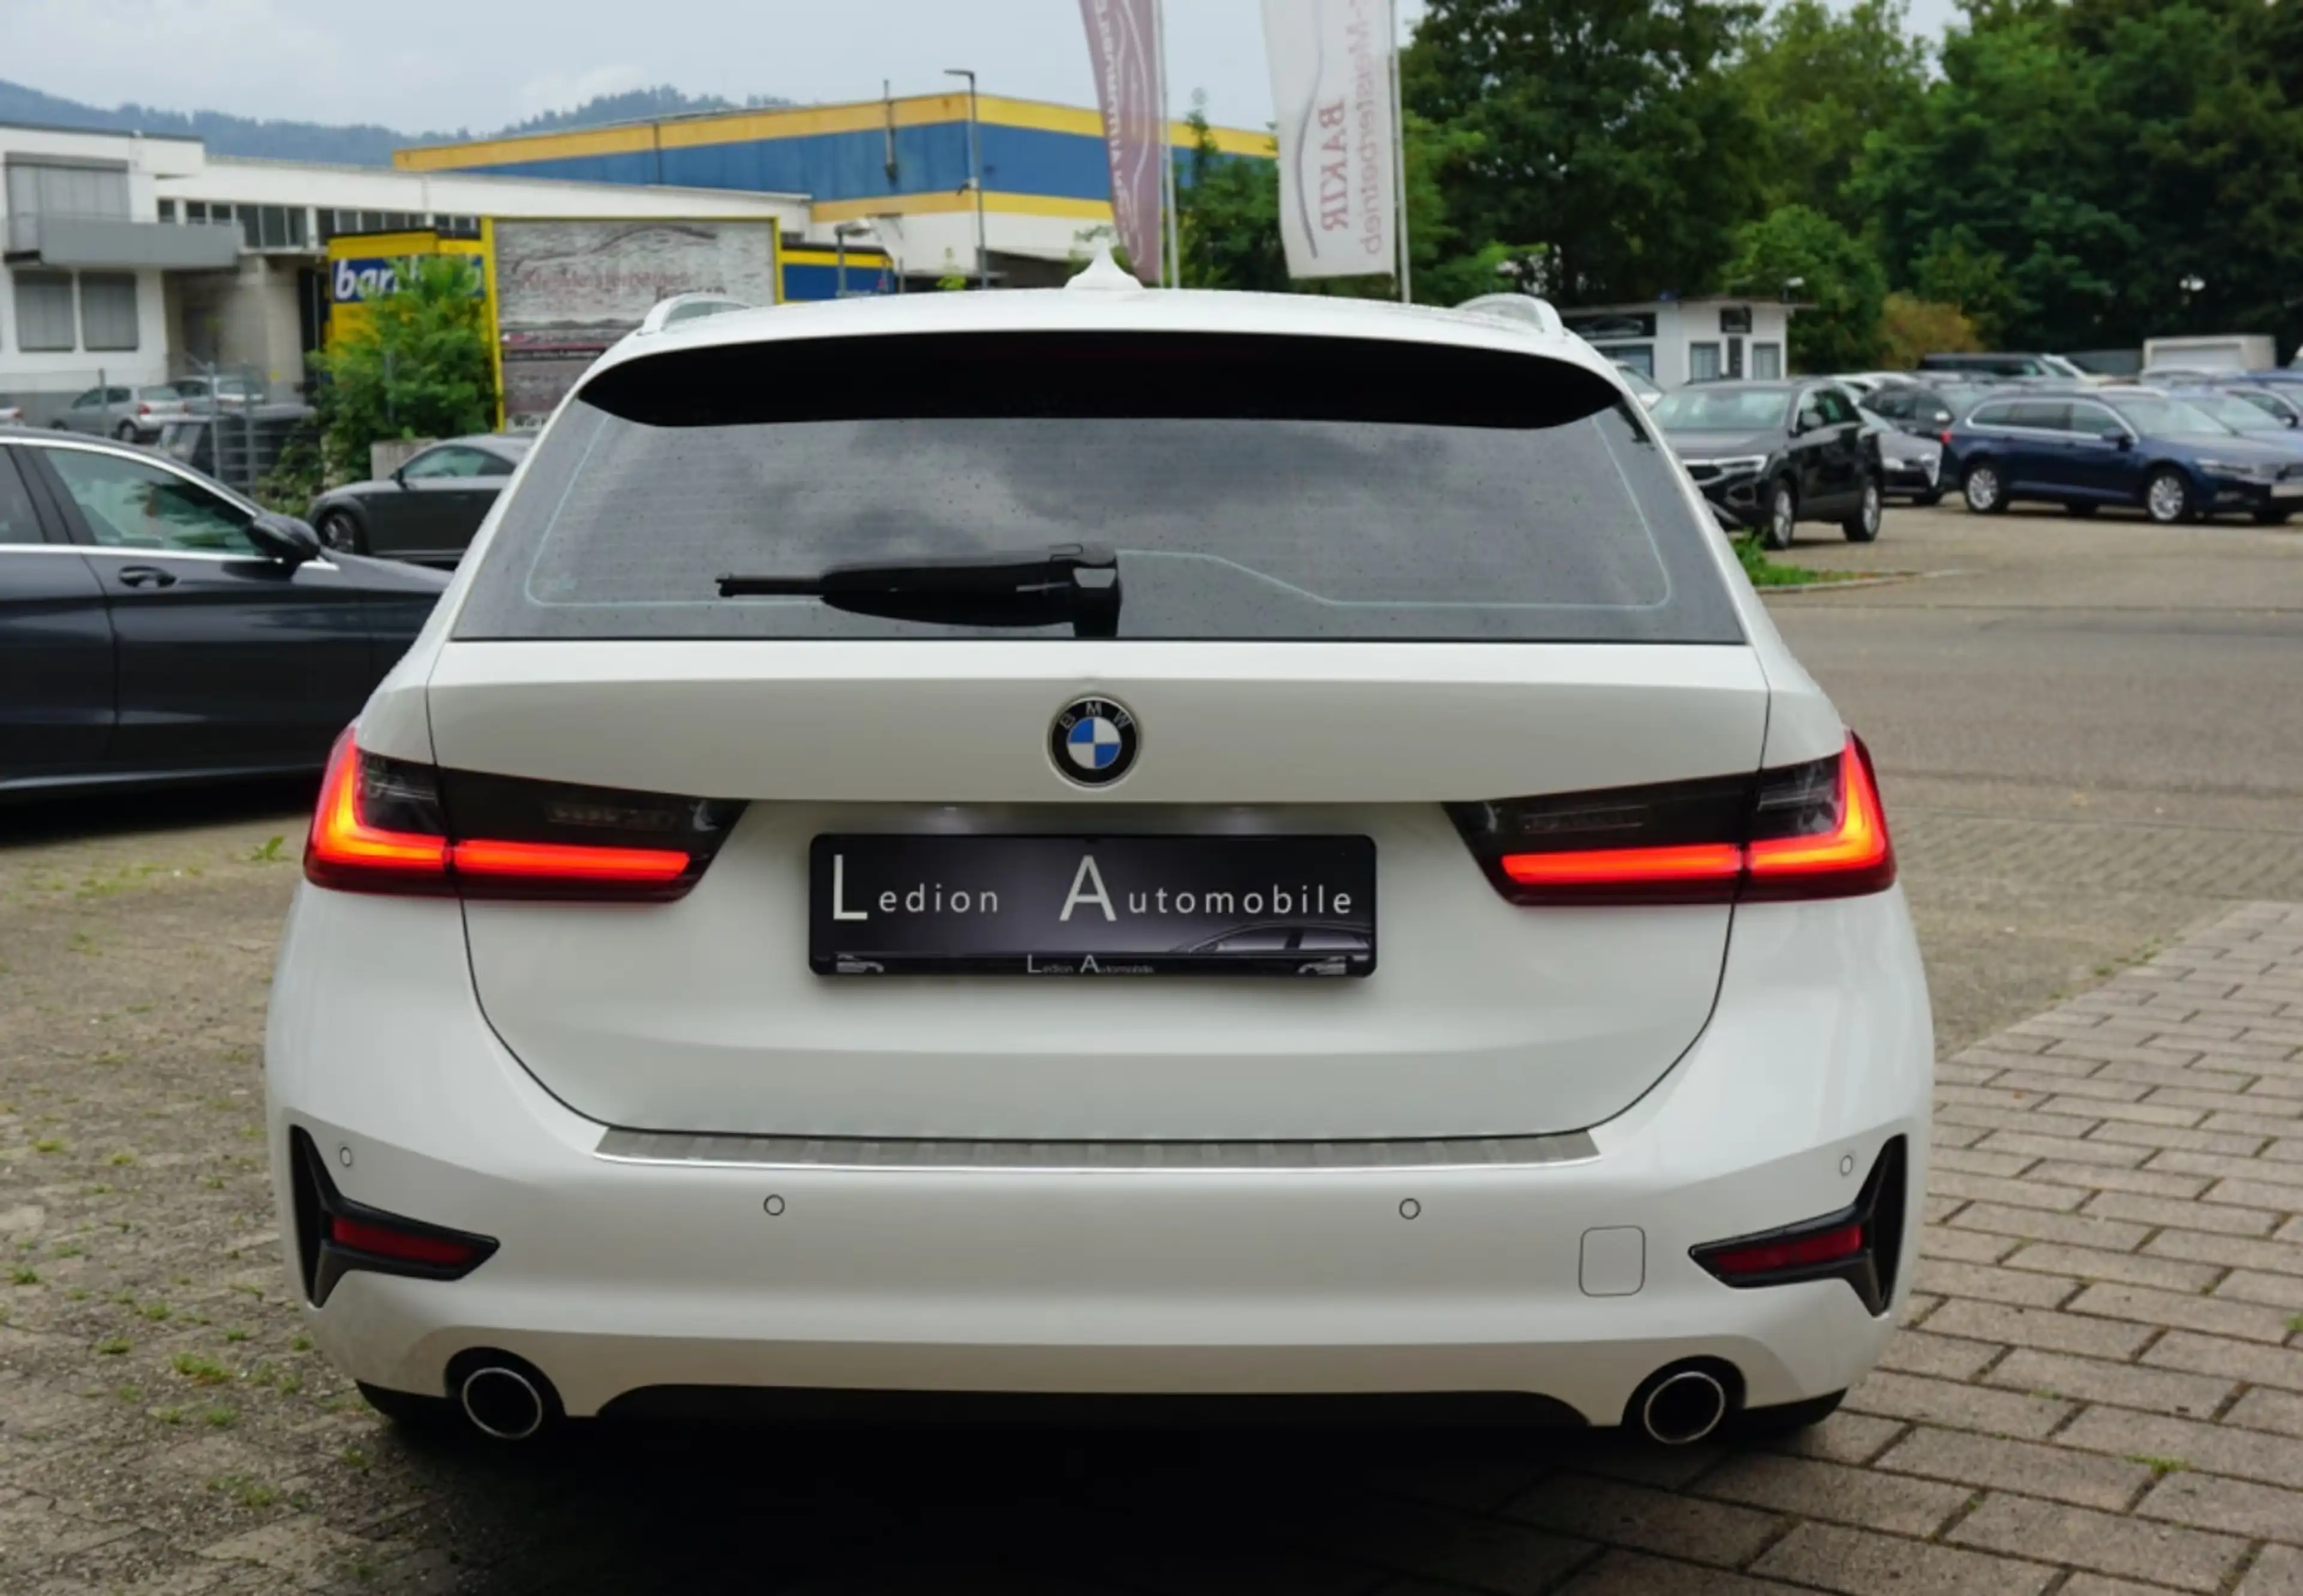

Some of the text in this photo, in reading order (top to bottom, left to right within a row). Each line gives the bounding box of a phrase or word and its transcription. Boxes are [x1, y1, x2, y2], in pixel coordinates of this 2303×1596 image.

[1058, 701, 1132, 730] BMW
[833, 854, 1352, 921] Ledion Automobile
